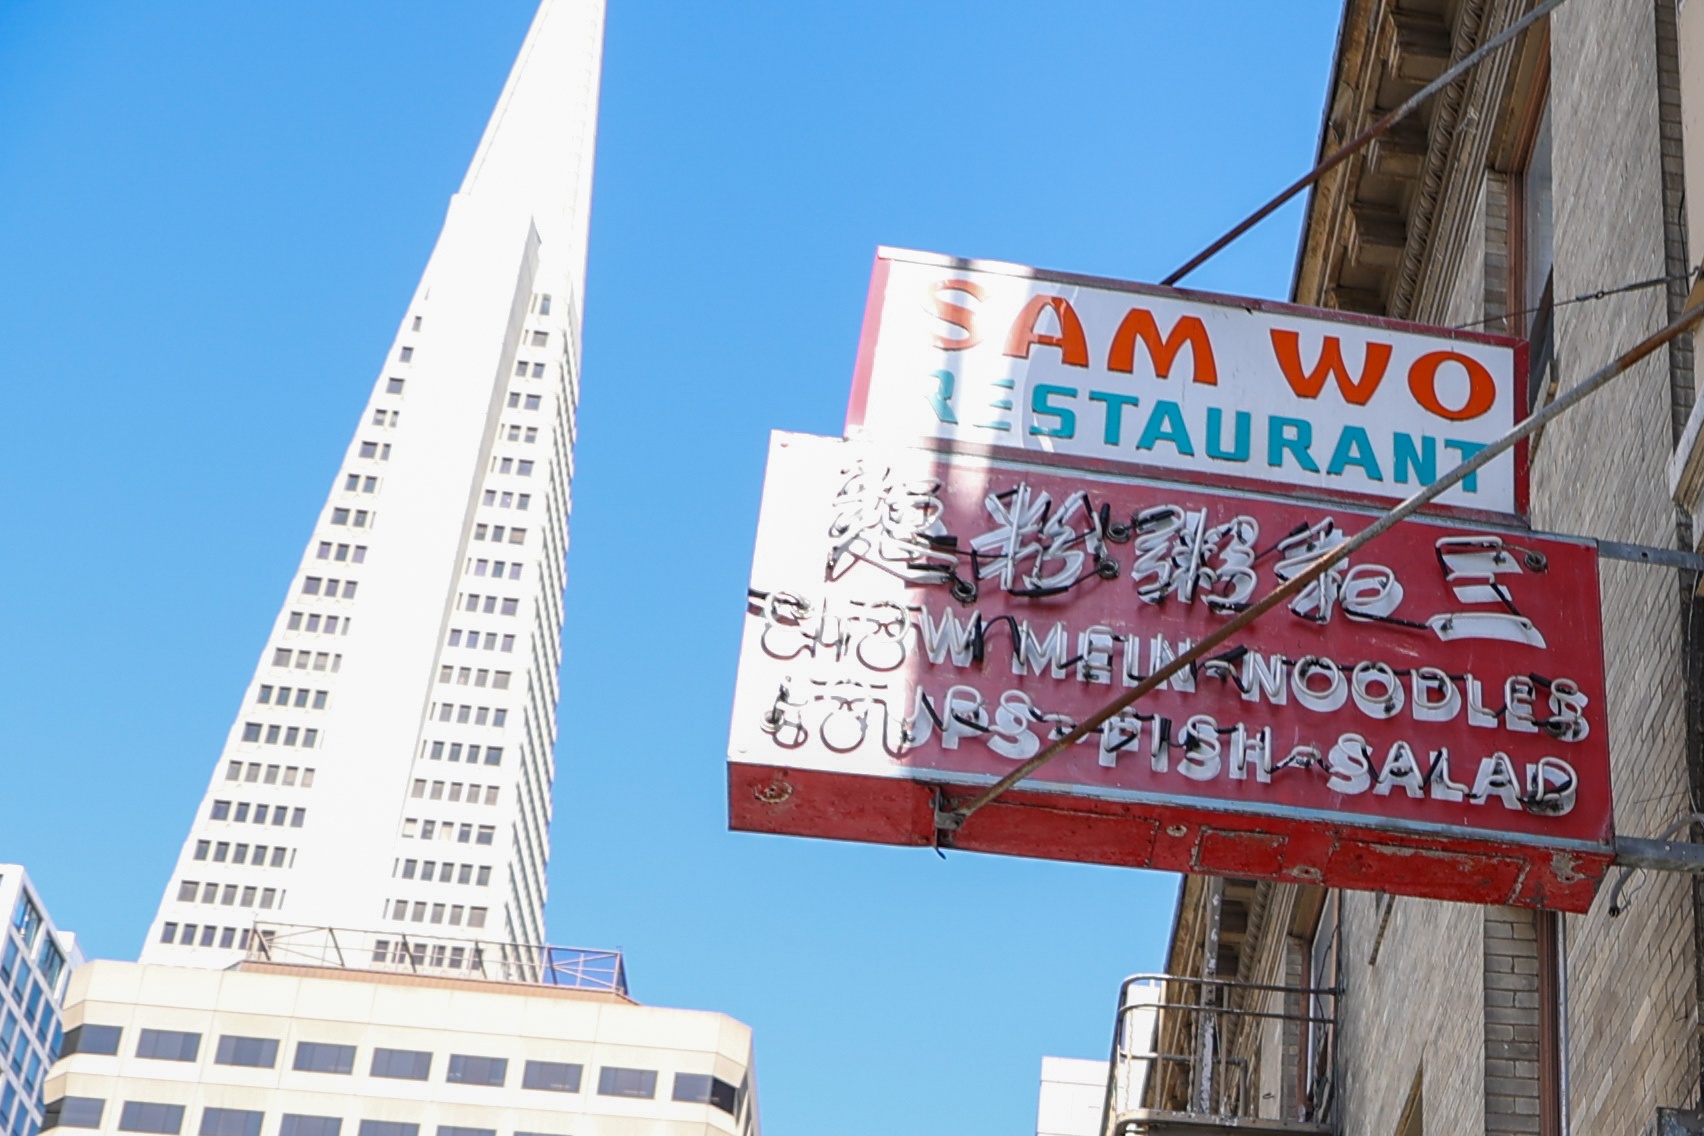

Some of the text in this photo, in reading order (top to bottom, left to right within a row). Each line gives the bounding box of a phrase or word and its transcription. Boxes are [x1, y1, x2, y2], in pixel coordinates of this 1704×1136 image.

[921, 277, 1498, 422] SAM WO
[924, 368, 1503, 494] RESTAURANT
[761, 590, 981, 672] CHOW
[1240, 648, 1591, 743] NOODLES
[1327, 732, 1579, 816] SALAD
